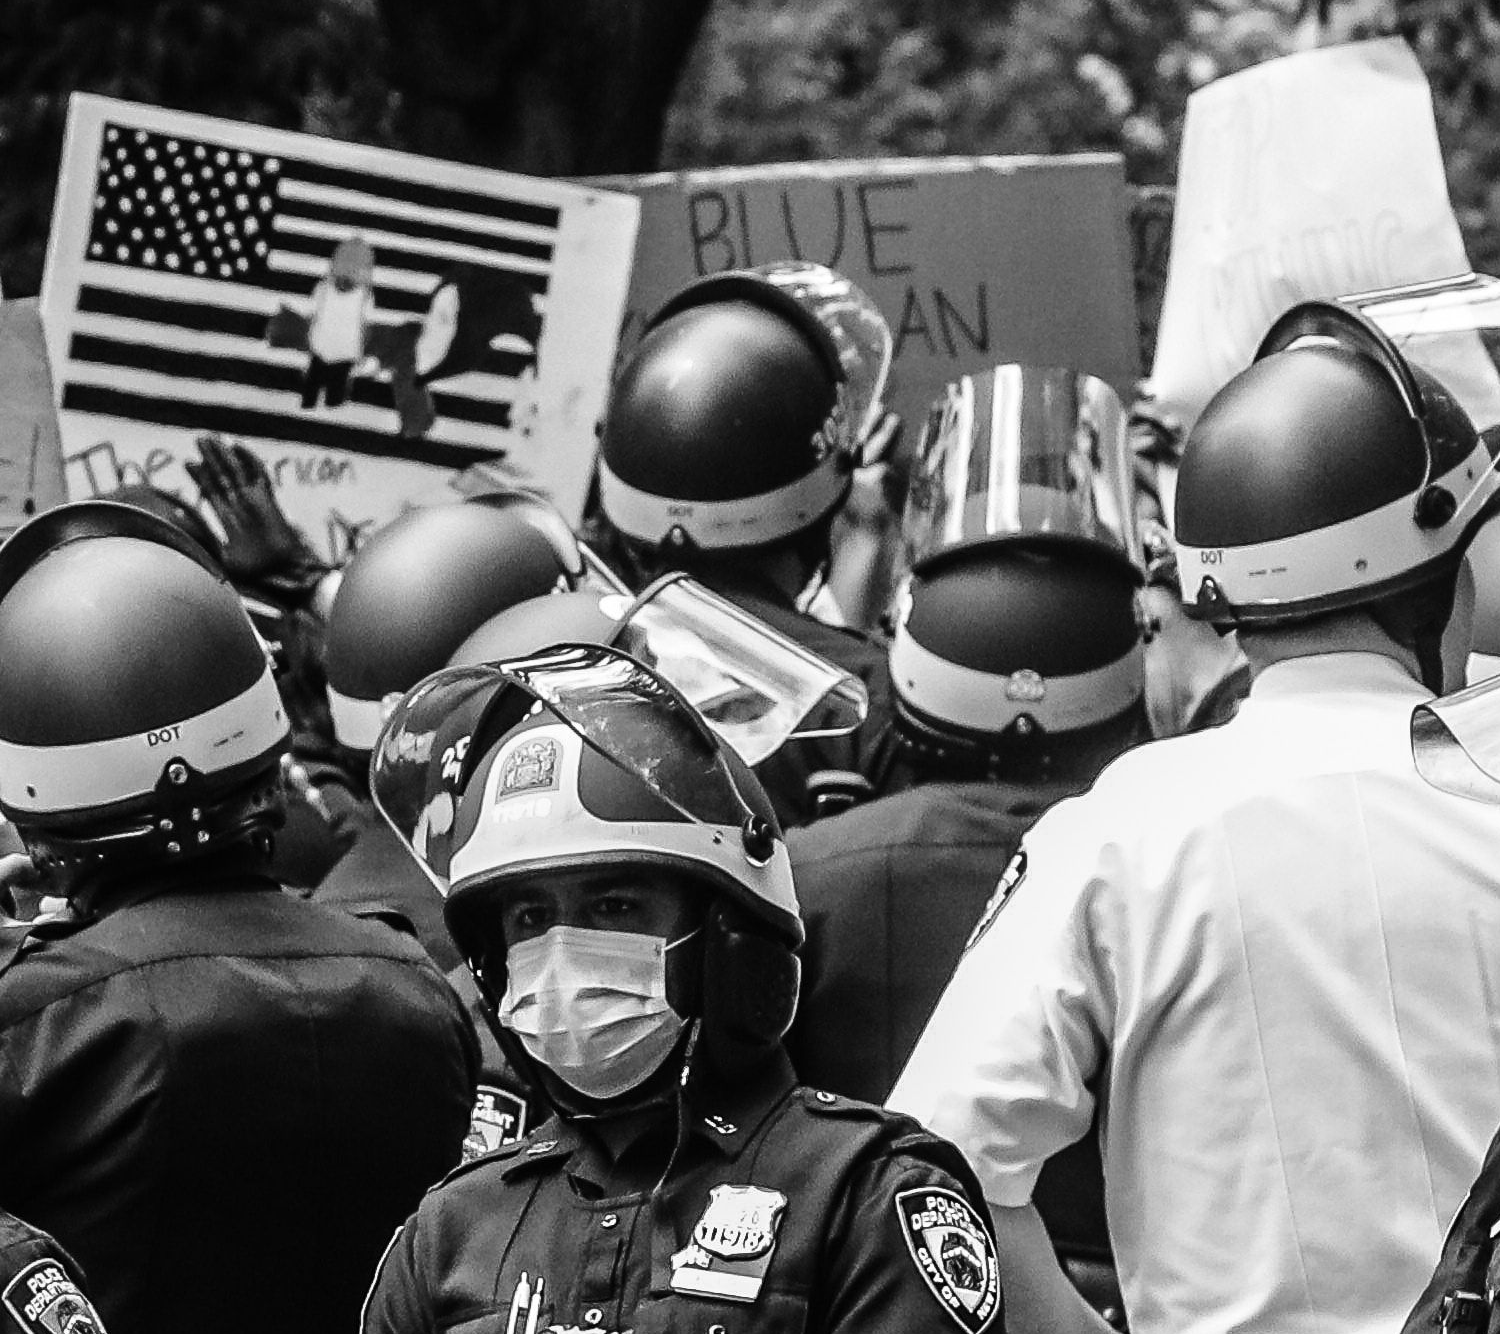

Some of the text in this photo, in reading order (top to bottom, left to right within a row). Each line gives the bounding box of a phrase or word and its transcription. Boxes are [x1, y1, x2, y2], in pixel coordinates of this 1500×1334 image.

[689, 178, 918, 277] BLUE
[147, 726, 181, 747] DOT
[918, 1248, 943, 1282] CITY
[942, 1286, 960, 1308] OF
